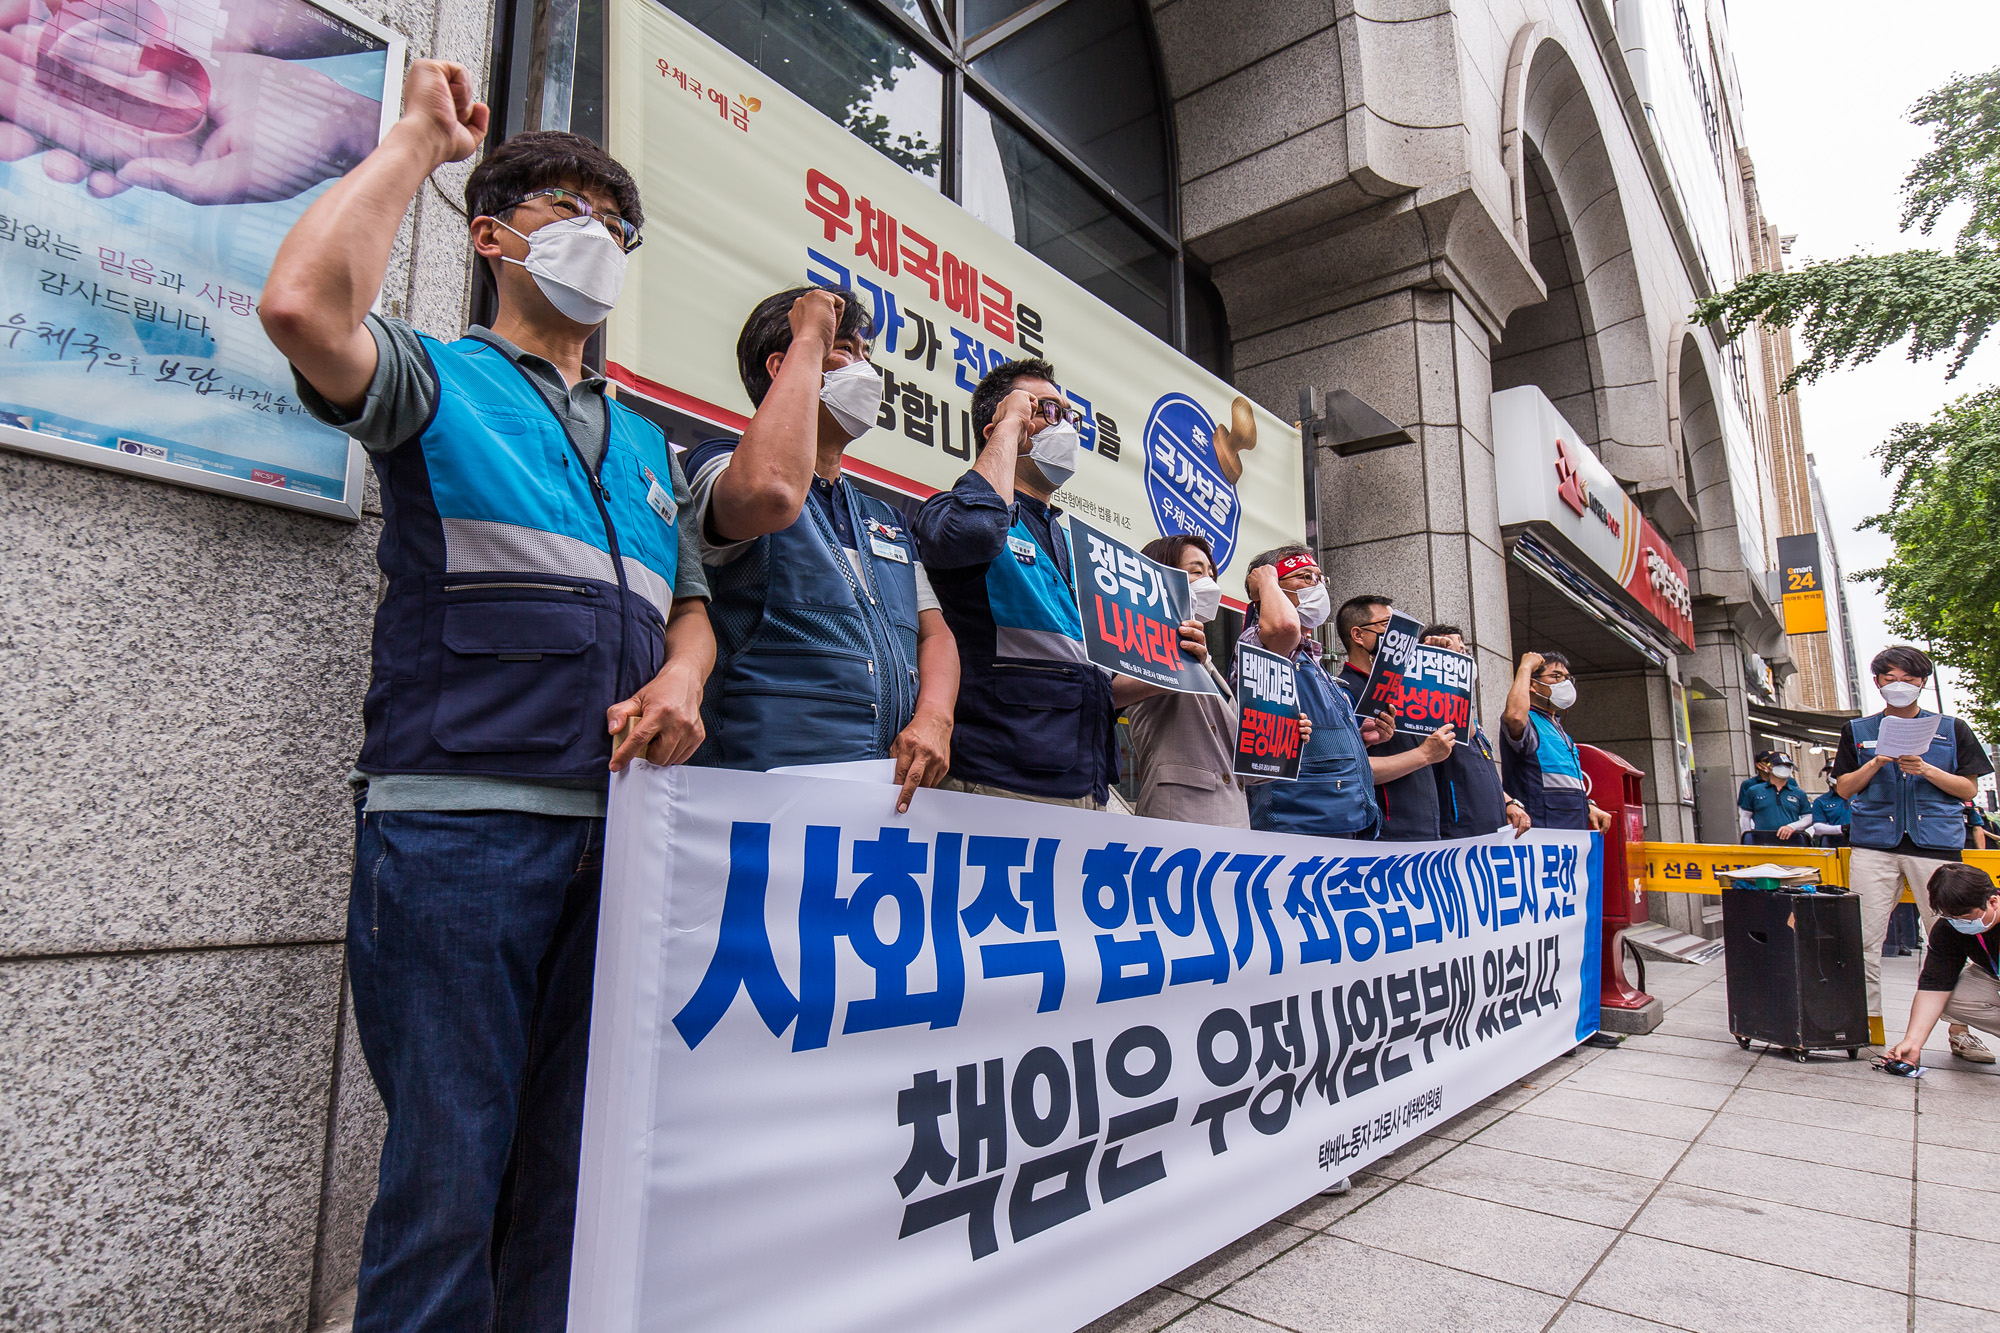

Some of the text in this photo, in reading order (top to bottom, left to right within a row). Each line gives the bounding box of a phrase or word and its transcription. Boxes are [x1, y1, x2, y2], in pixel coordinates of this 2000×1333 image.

[655, 58, 750, 133] 우체국 예금
[98, 246, 186, 294] 믿음과
[196, 283, 261, 316] 사랑
[805, 168, 1044, 359] 우체국예금은
[38, 269, 216, 342] 감사드립니다.
[0, 313, 146, 376] 우체국으로
[1052, 489, 1097, 517] 금보험에관한
[1154, 433, 1233, 526] 국가보증
[1087, 533, 1172, 619] 정부가
[1787, 565, 1813, 575] emart
[1788, 572, 1816, 590] 24
[1094, 593, 1185, 671] 나서라!
[1242, 651, 1297, 706] 택배과로
[1404, 649, 1471, 692] 회적합의
[1663, 863, 1703, 879] 선을
[671, 821, 1578, 1054] 사회적 합의가 최종합의에 이르지 못한
[893, 1025, 1178, 1261] 책임은
[1190, 954, 1476, 1157] 우정사업본부에
[1318, 1085, 1443, 1172] 택배노동자 과로사 대책위원회
